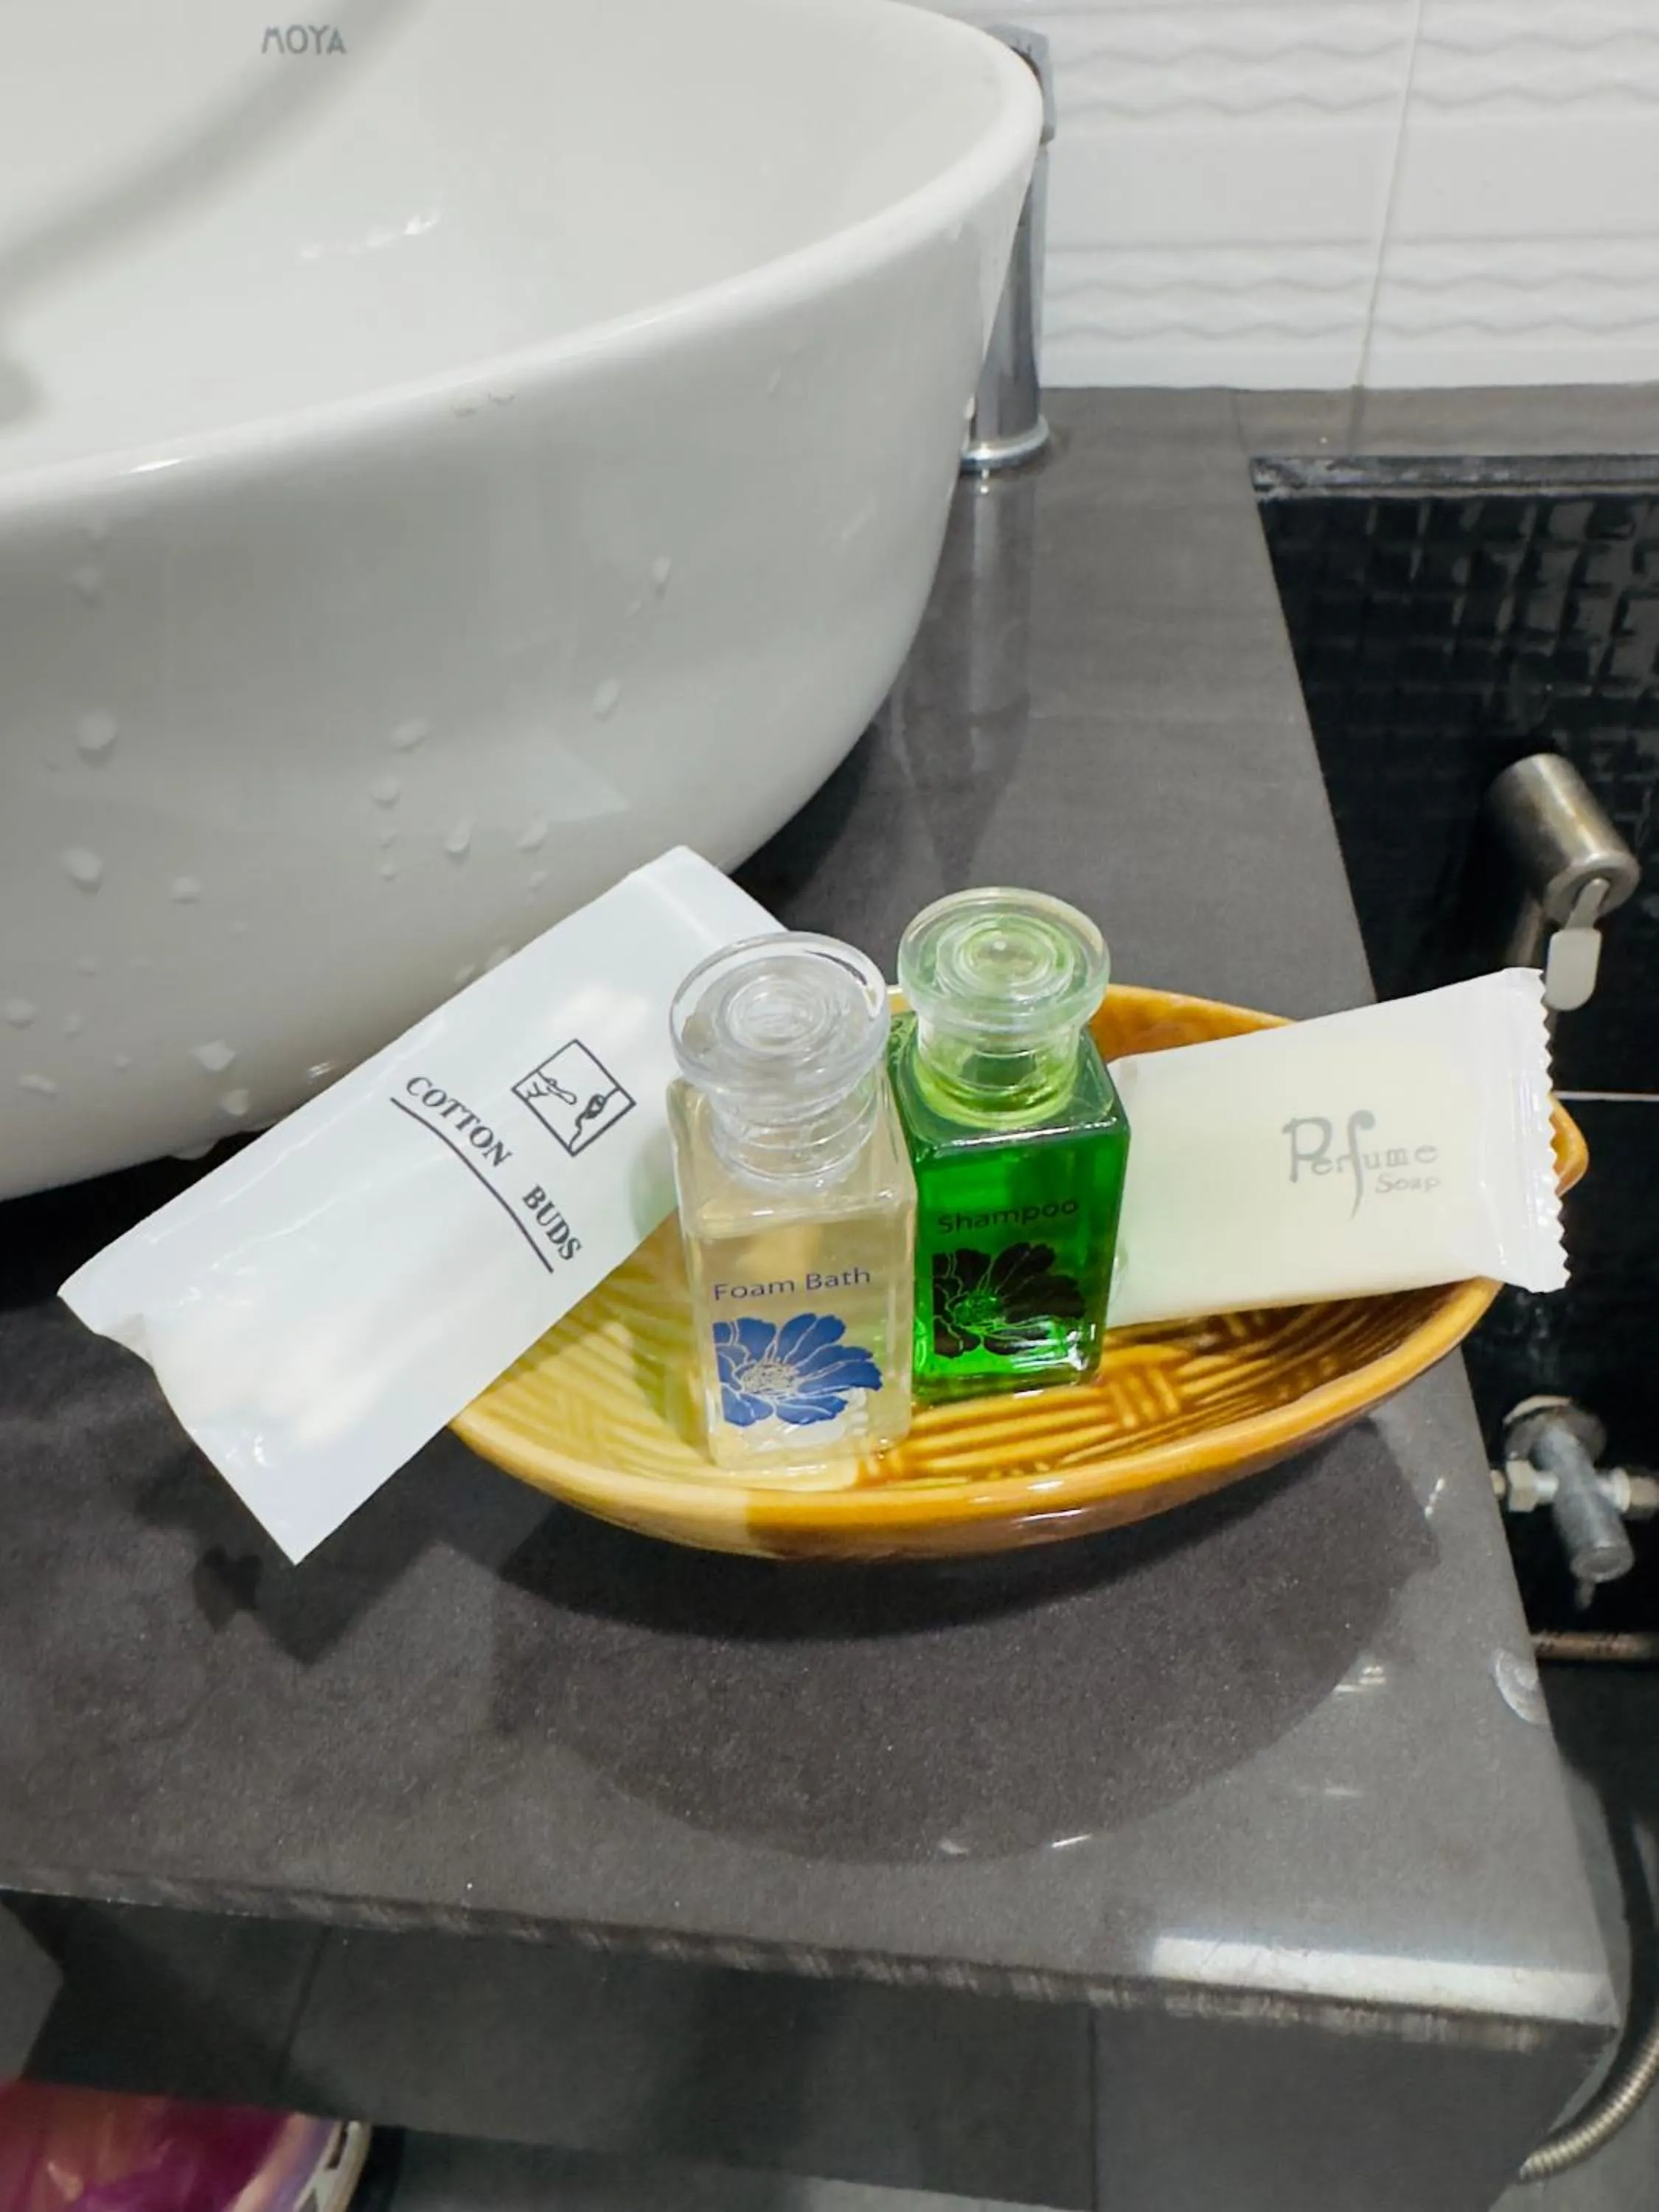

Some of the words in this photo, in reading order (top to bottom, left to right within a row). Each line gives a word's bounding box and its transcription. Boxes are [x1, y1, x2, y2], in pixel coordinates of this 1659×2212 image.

[261, 24, 347, 55] MOYA
[406, 1076, 512, 1167] COTTON
[522, 1185, 582, 1261] BUDS
[1281, 1109, 1439, 1219] Perfume
[1375, 1172, 1441, 1194] Soap
[937, 1198, 1079, 1234] Shampoo
[713, 1279, 796, 1301] Foam
[805, 1267, 871, 1291] Bath
